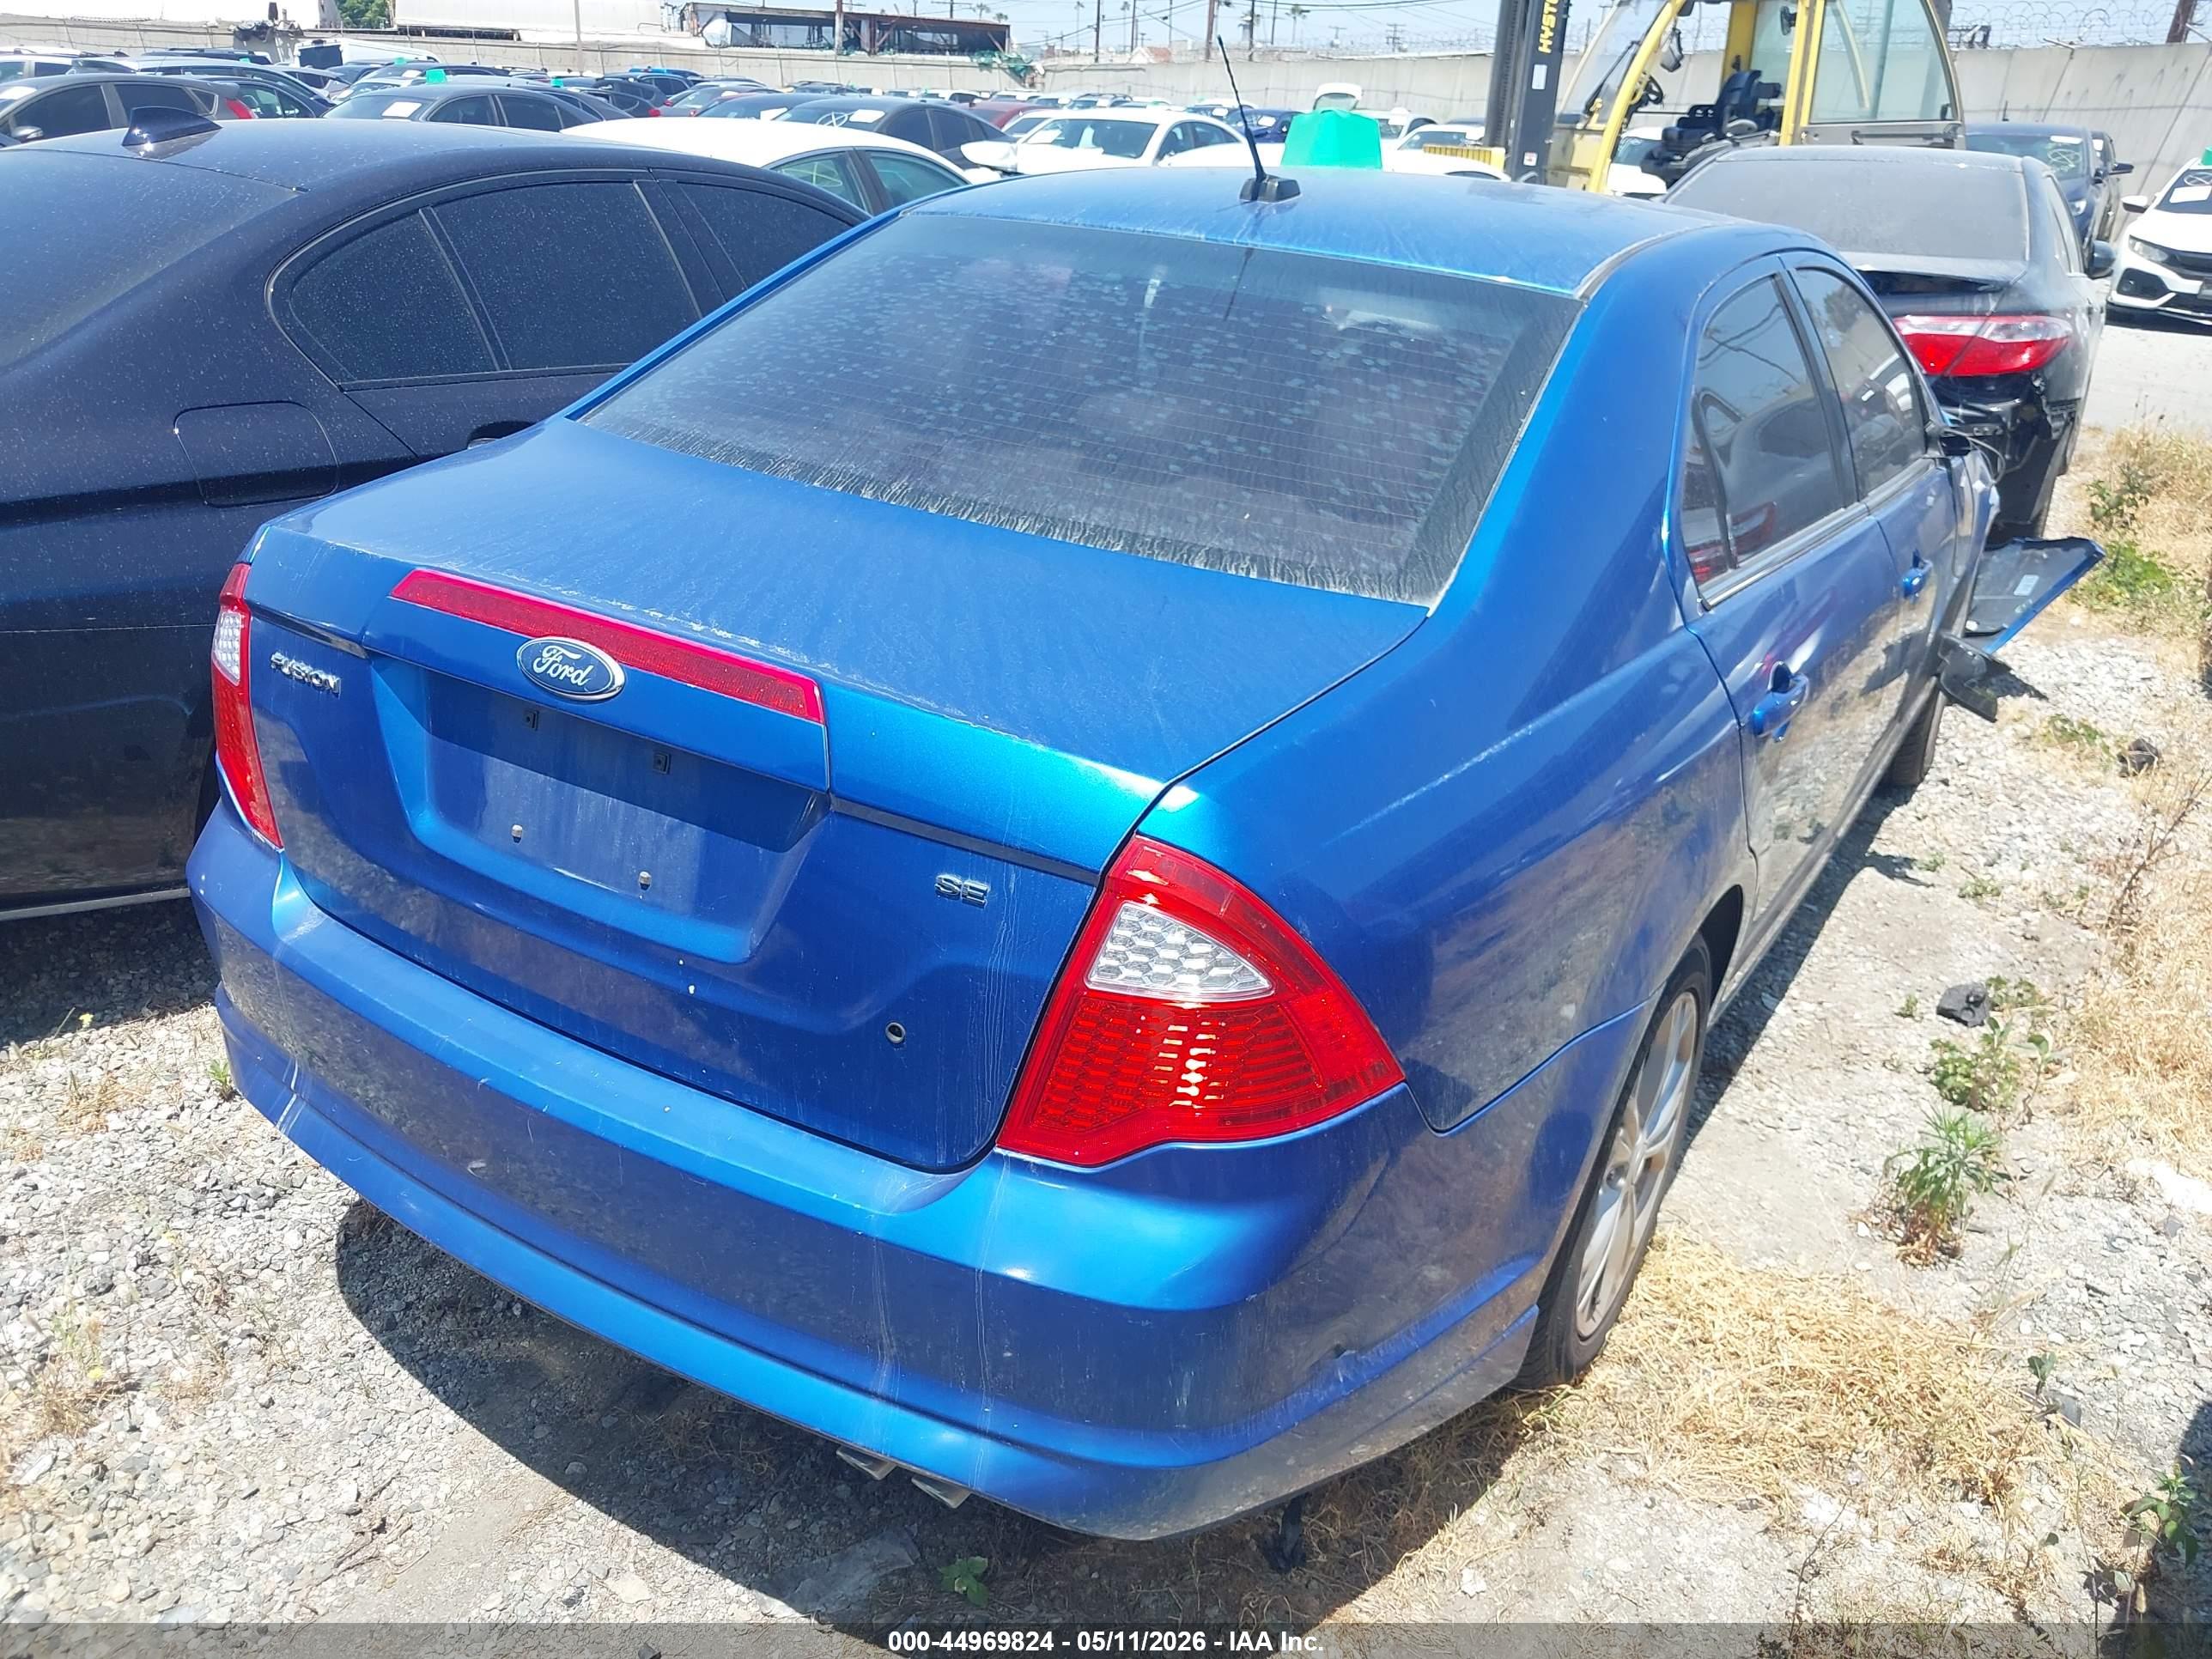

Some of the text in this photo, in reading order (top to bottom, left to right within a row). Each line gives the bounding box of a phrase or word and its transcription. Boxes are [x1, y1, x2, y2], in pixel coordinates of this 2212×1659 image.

[270, 652, 341, 694] FUSION
[532, 645, 594, 686] Ford
[934, 873, 989, 906] SE
